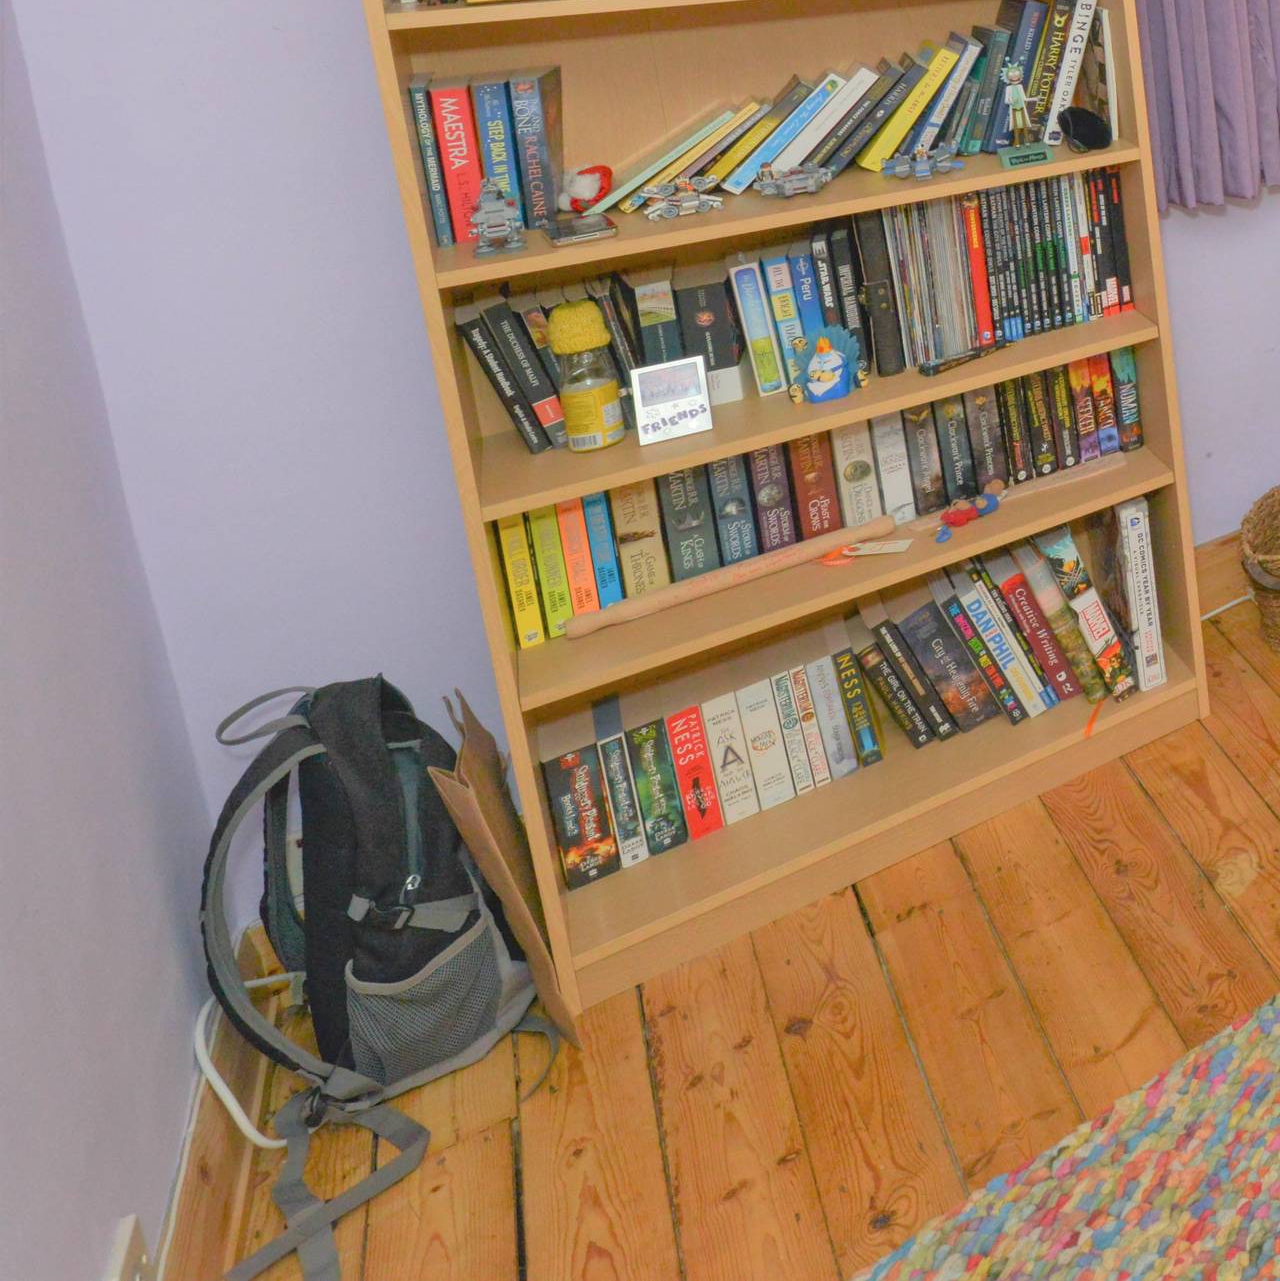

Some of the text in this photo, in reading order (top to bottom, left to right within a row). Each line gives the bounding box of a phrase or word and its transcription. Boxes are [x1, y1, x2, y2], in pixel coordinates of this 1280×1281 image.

[1069, 3, 1092, 55] BINGE
[1035, 32, 1065, 114] HARRY POTTER
[1064, 59, 1078, 87] TYLER
[439, 98, 469, 170] MAESTRA
[487, 120, 505, 141] STEP
[514, 100, 532, 135] BONE
[414, 93, 430, 138] MYTHOLOGY
[427, 157, 440, 191] MERMAID
[490, 142, 507, 162] BACK
[493, 165, 507, 173] IN
[525, 136, 547, 216] RACHEL CAINE
[969, 209, 979, 248] CONVERGENCE
[1030, 200, 1041, 243] LANTERN CORPS
[799, 277, 813, 301] Peru
[817, 260, 834, 308] STAR WARS
[838, 265, 860, 330] IMPERIAL HANDBOOK
[500, 320, 540, 387] THE DUCHESS OF MALFI
[485, 353, 503, 373] Student
[495, 372, 515, 397] Handbook
[641, 404, 707, 434] FRIENDS
[1077, 397, 1095, 435] SEEKER
[1119, 382, 1138, 424] NOMAN
[947, 420, 964, 485] Clockwork Prince
[979, 412, 995, 476] Clockwork Princess
[668, 472, 687, 510] MARTIN
[819, 499, 830, 520] FEAST
[766, 508, 781, 546] SWORDS
[779, 510, 790, 536] STORM
[808, 499, 822, 531] CROWS
[680, 540, 694, 570] KINGS
[693, 538, 705, 561] CLASH
[727, 521, 743, 560] SWORDS
[740, 523, 752, 549] STORM
[1137, 532, 1144, 543] DC
[607, 568, 616, 583] JAMES
[629, 549, 646, 595] THRONES
[646, 556, 657, 580] GAME
[1139, 544, 1147, 570] COMICS
[584, 588, 593, 603] JAMES
[597, 567, 607, 589] DASHNER
[1145, 592, 1151, 602] BY
[515, 590, 526, 612] DASHNER
[525, 590, 534, 606] JAMES
[547, 590, 558, 613] DASHNER
[557, 591, 566, 607] JAMES
[574, 587, 586, 609] DASHNER
[967, 599, 993, 635] DAN
[987, 637, 1015, 670] PHIL
[1015, 588, 1058, 665] Creative Writing
[792, 669, 813, 713] MAGISTERIUM
[836, 654, 860, 699] NESS
[931, 638, 979, 712] City Heavenly Fire
[880, 661, 928, 733] THE GIRL ON THE TRAIN
[672, 719, 694, 766] NESS
[688, 713, 704, 758] PATRICK
[582, 811, 600, 841] Pleasant
